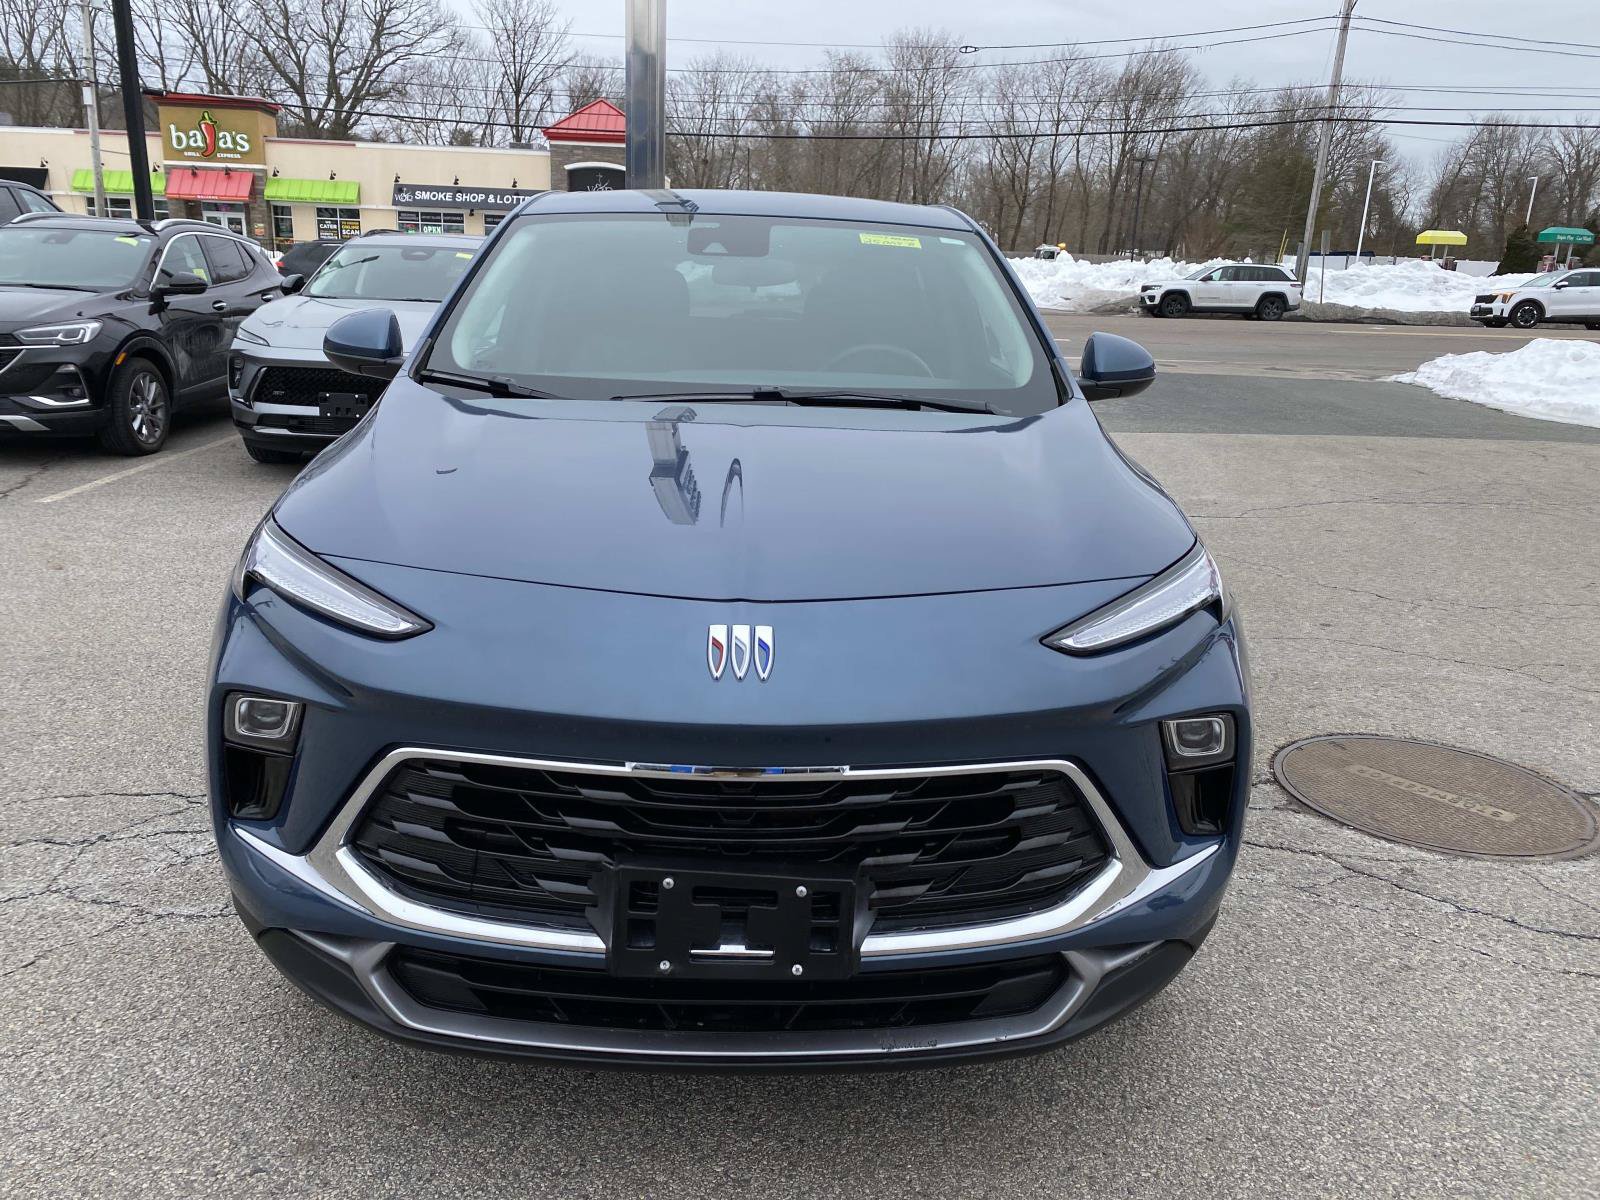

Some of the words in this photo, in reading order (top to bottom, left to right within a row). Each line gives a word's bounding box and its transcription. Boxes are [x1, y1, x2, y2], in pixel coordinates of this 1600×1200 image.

[415, 190, 453, 202] SMOKE
[455, 192, 485, 203] SHOP
[487, 193, 496, 204] &
